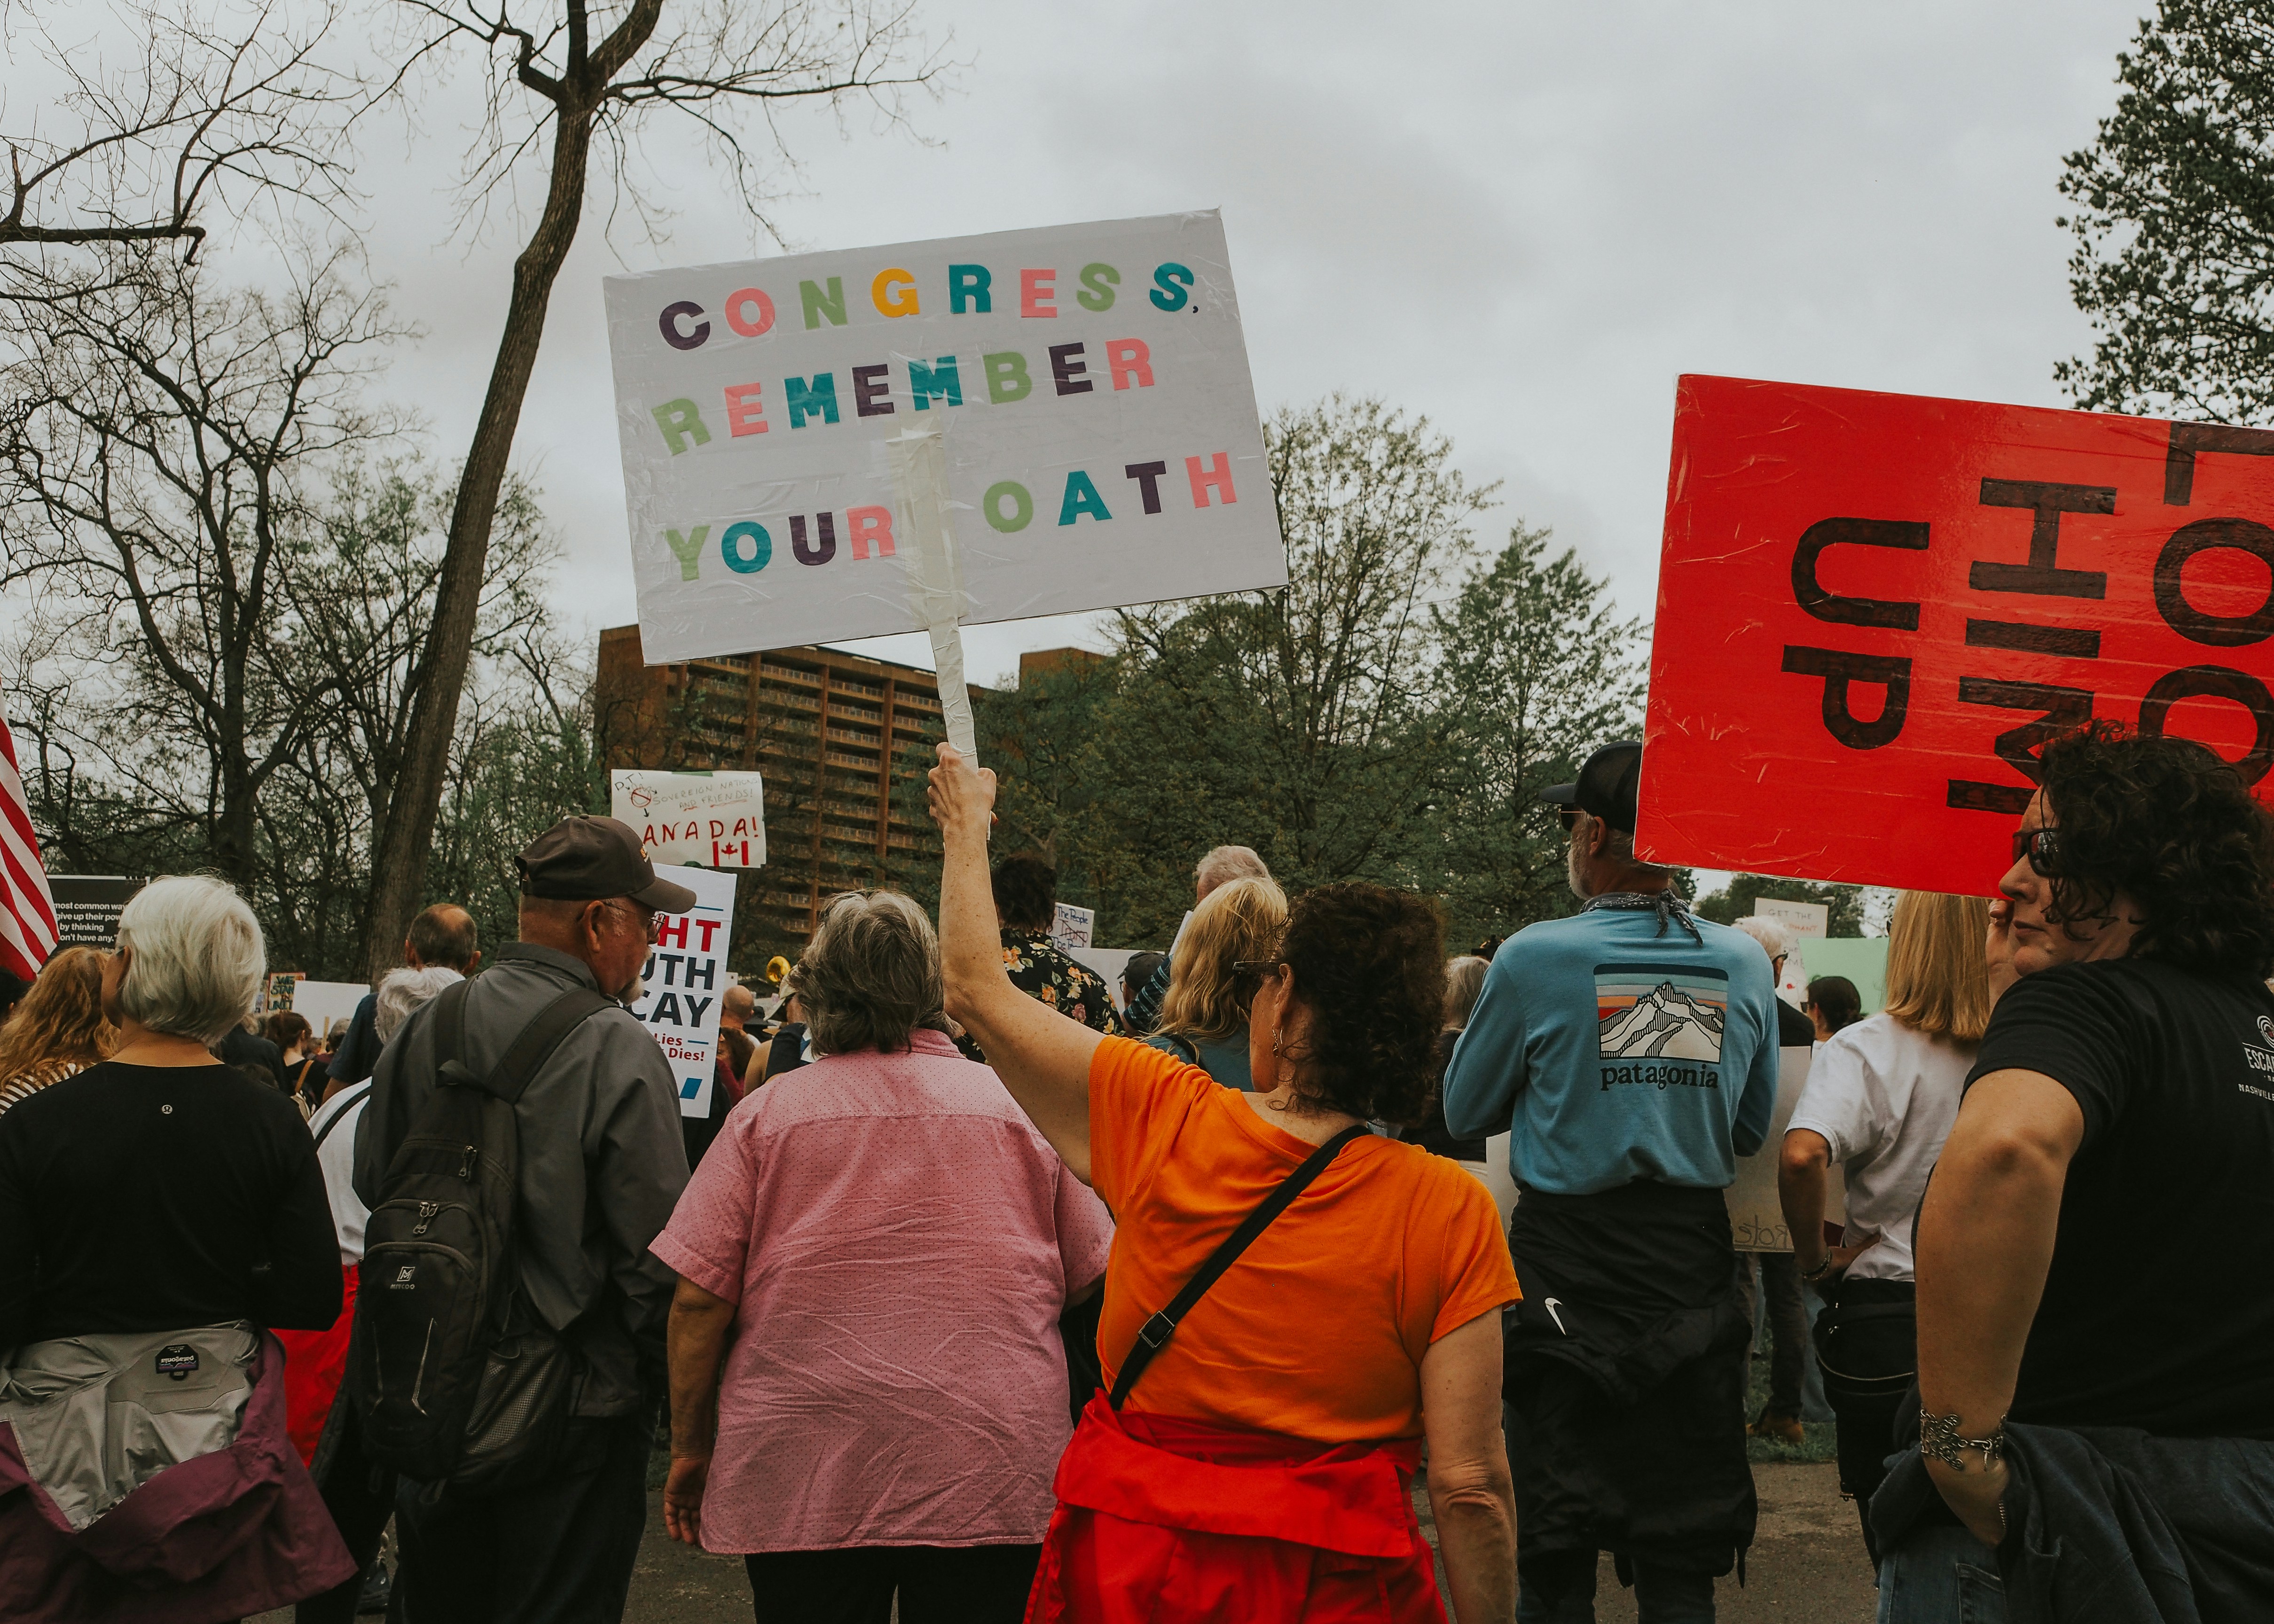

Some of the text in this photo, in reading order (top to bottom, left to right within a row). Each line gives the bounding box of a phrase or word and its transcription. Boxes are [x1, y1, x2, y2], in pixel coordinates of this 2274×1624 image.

[659, 262, 1200, 351] CONGRESS,
[651, 337, 1155, 455] REMEMBER
[666, 451, 1238, 582] YOUR OATH
[1780, 516, 1930, 750] UP
[1946, 476, 2117, 815] HIM
[652, 777, 760, 805] SOVEREIGN NATIONS!
[679, 788, 753, 809] AND FRIENDS!
[59, 922, 104, 932] by thinking
[668, 1047, 705, 1062] Dies!
[1600, 1063, 1718, 1091] patagonia
[161, 1355, 194, 1364] patagonia
